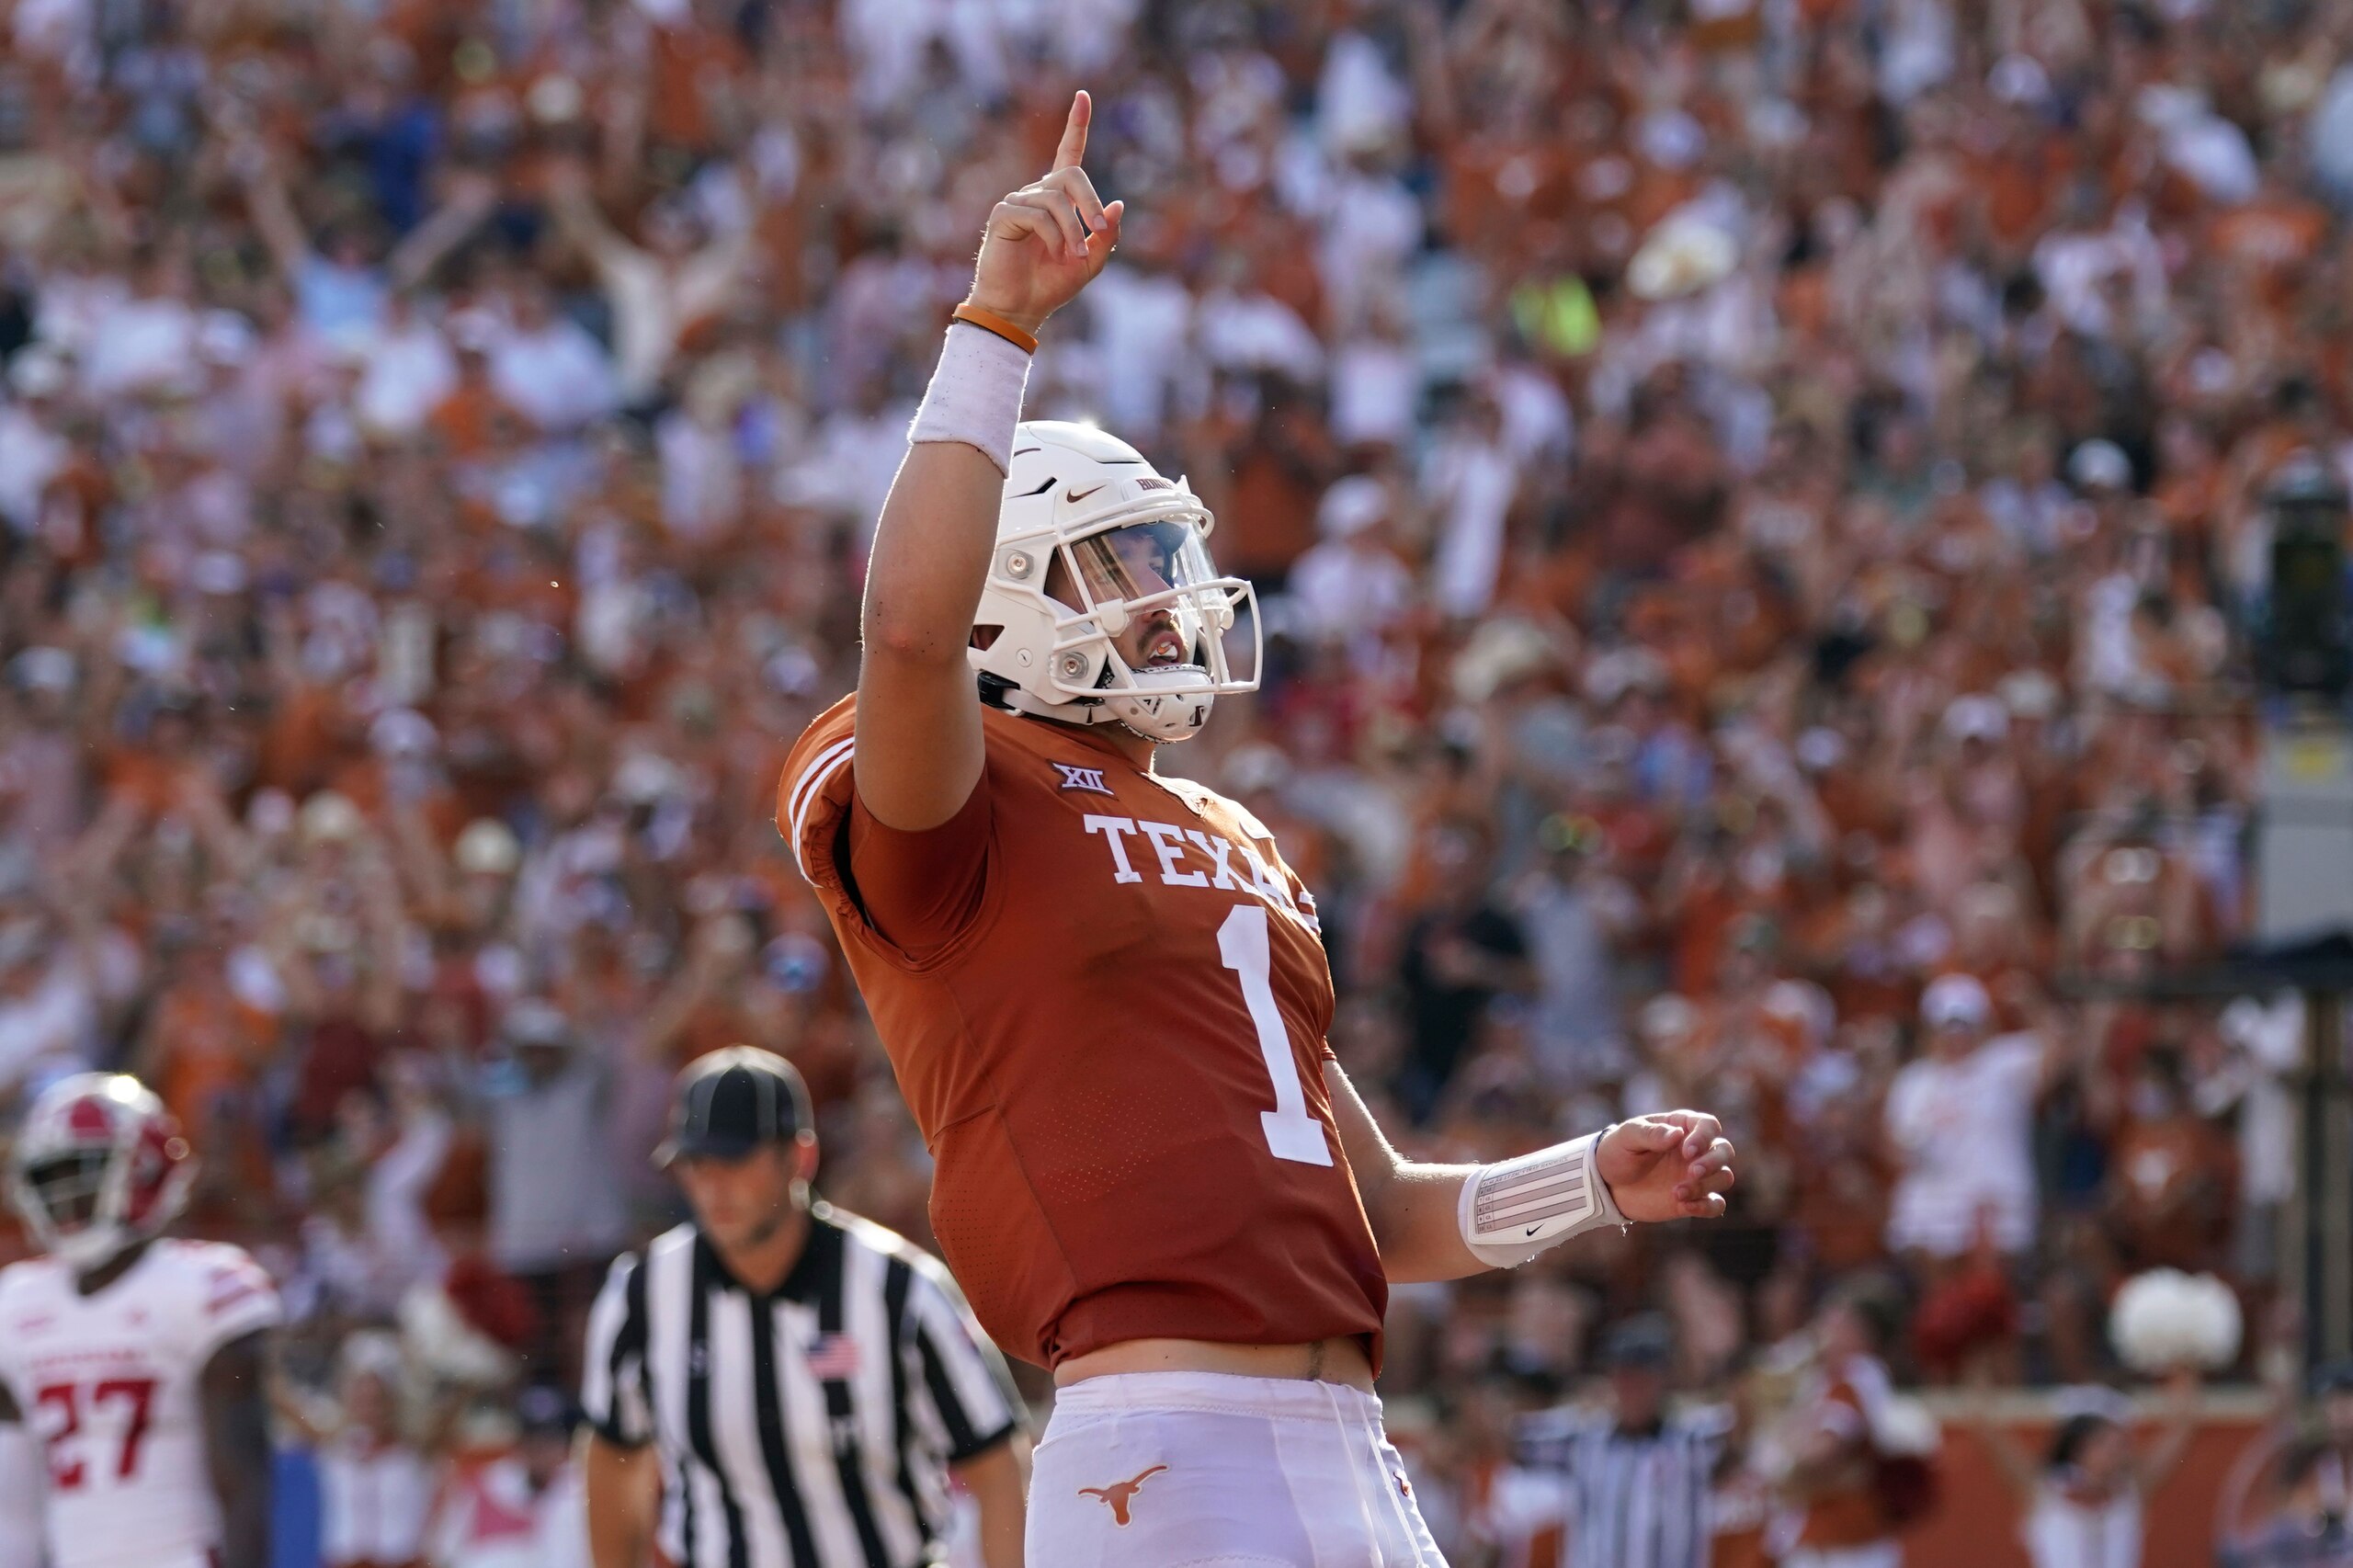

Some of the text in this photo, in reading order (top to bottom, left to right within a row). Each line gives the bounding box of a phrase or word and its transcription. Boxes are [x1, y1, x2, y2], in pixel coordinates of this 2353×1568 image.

[1135, 478, 1174, 491] HORNS
[1052, 762, 1115, 795] XII
[1215, 903, 1334, 1167] 1
[39, 1380, 156, 1487] 27
